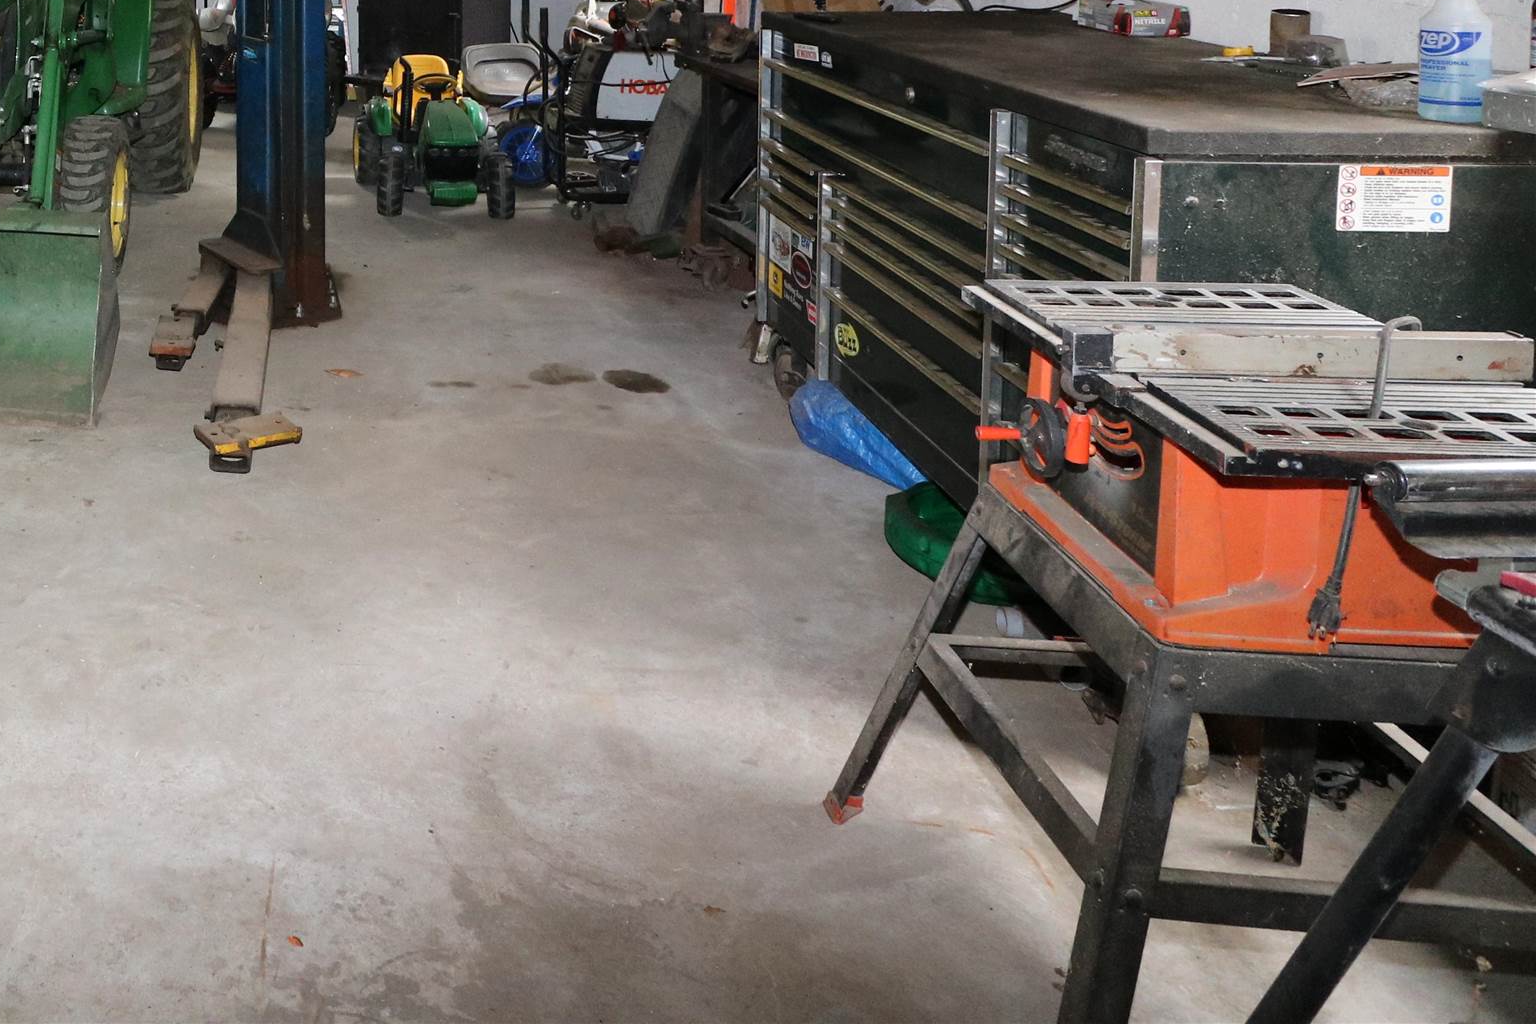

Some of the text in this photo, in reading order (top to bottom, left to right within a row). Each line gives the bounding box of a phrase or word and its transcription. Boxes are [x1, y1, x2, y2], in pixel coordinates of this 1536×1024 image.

[1134, 17, 1166, 25] NITRILE
[620, 78, 669, 95] HOBA
[1389, 167, 1435, 176] WARNING
